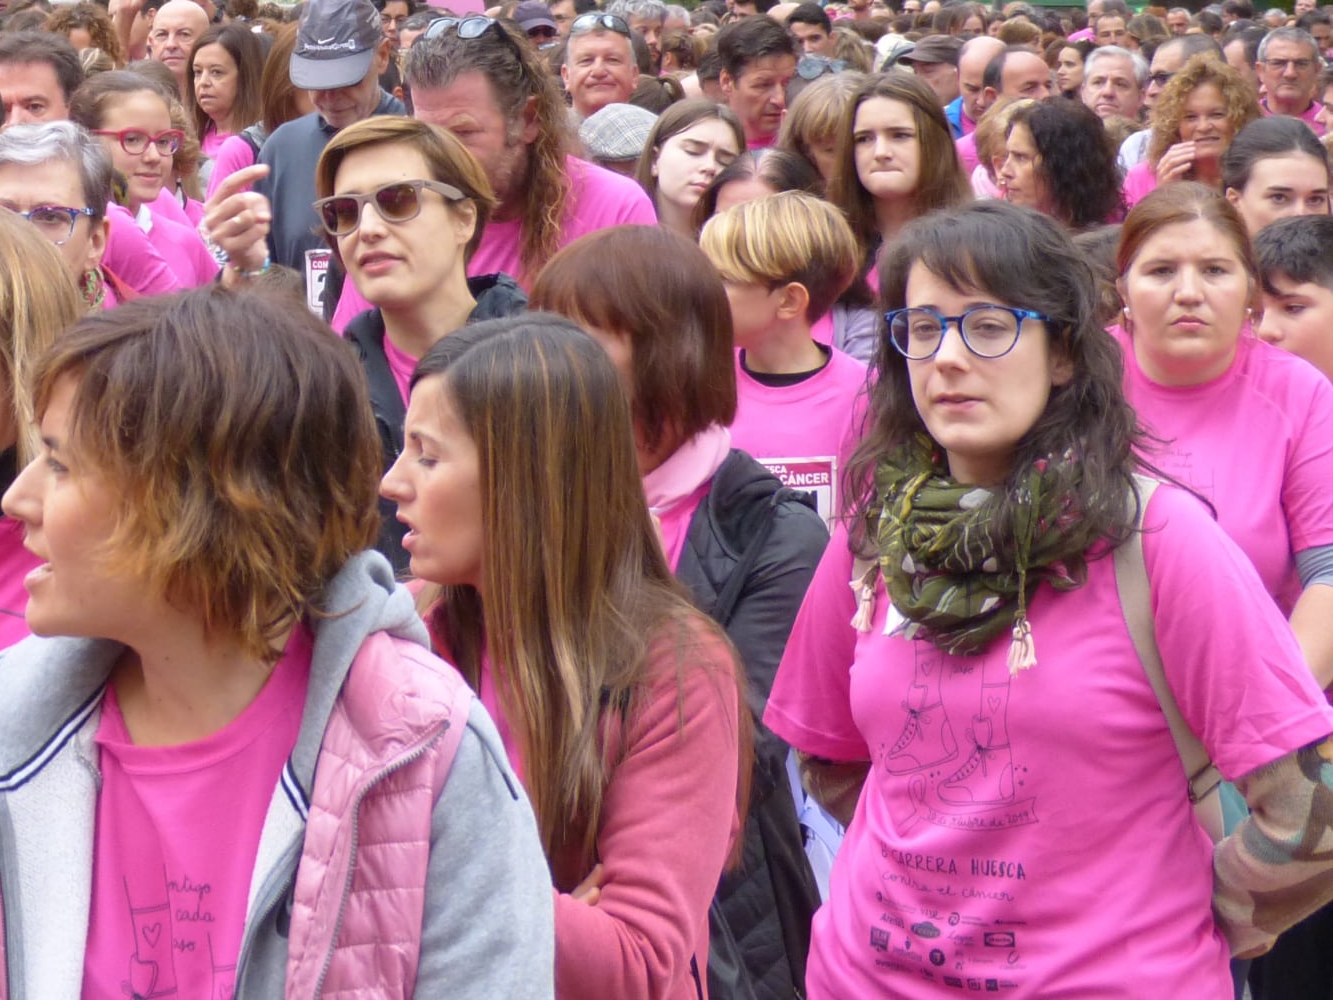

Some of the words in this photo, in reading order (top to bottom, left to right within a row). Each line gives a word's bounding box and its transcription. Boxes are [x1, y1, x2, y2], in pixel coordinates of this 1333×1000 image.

[779, 471, 829, 486] CÁNCER
[971, 858, 1026, 881] HUESCA
[168, 875, 211, 901] ntigo
[174, 940, 195, 952] aso
